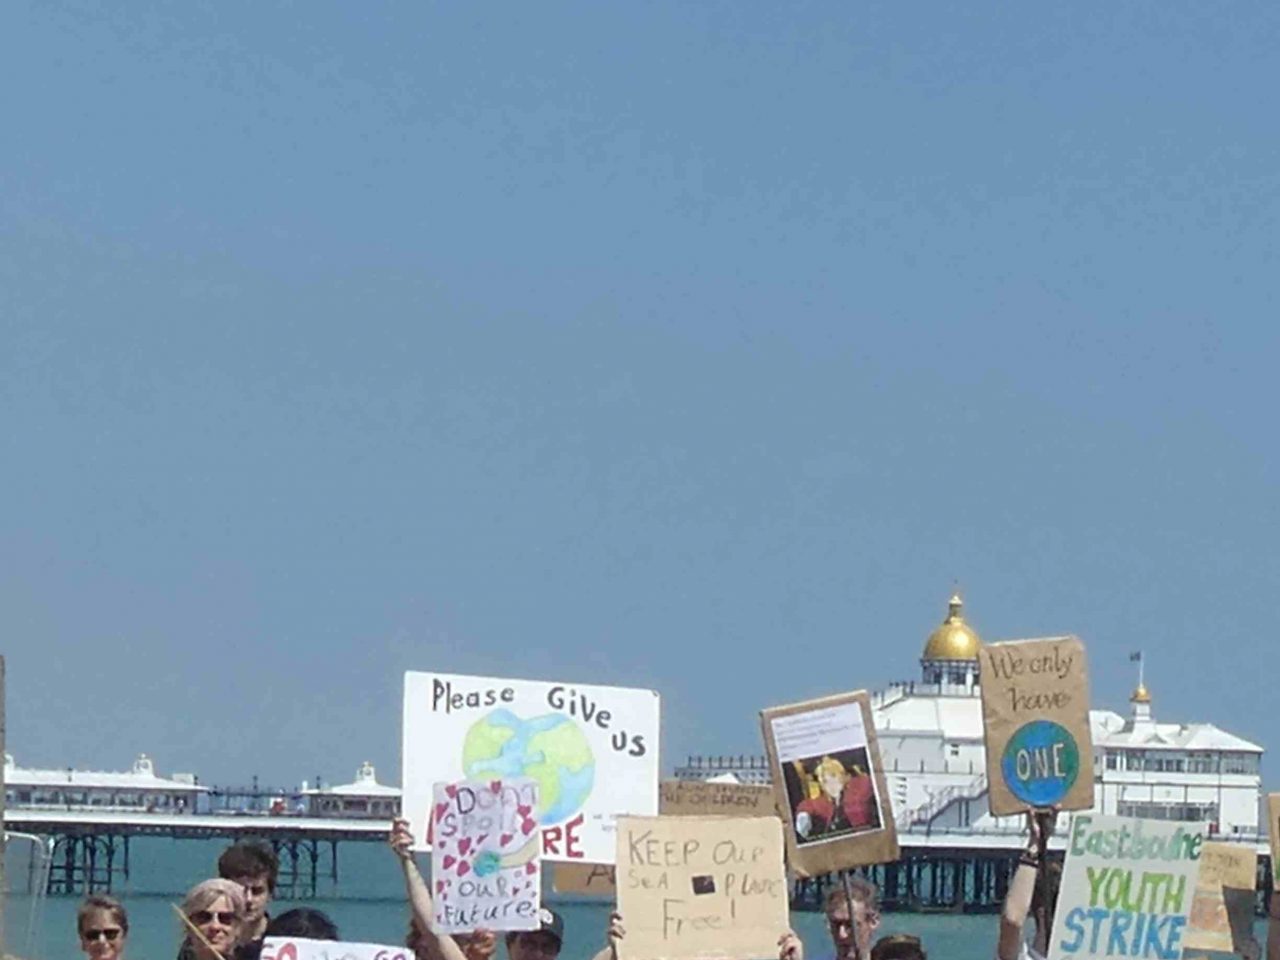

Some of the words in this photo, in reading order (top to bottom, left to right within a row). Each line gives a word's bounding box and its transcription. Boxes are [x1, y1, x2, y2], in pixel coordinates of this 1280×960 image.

[988, 650, 1025, 680] We
[1029, 646, 1073, 680] only
[432, 678, 515, 714] Please
[547, 686, 612, 728] Give
[1007, 686, 1072, 712] have
[611, 730, 647, 757] us
[1016, 742, 1067, 781] ONE
[628, 829, 701, 866] KEEP
[1086, 866, 1187, 914] YOUTH
